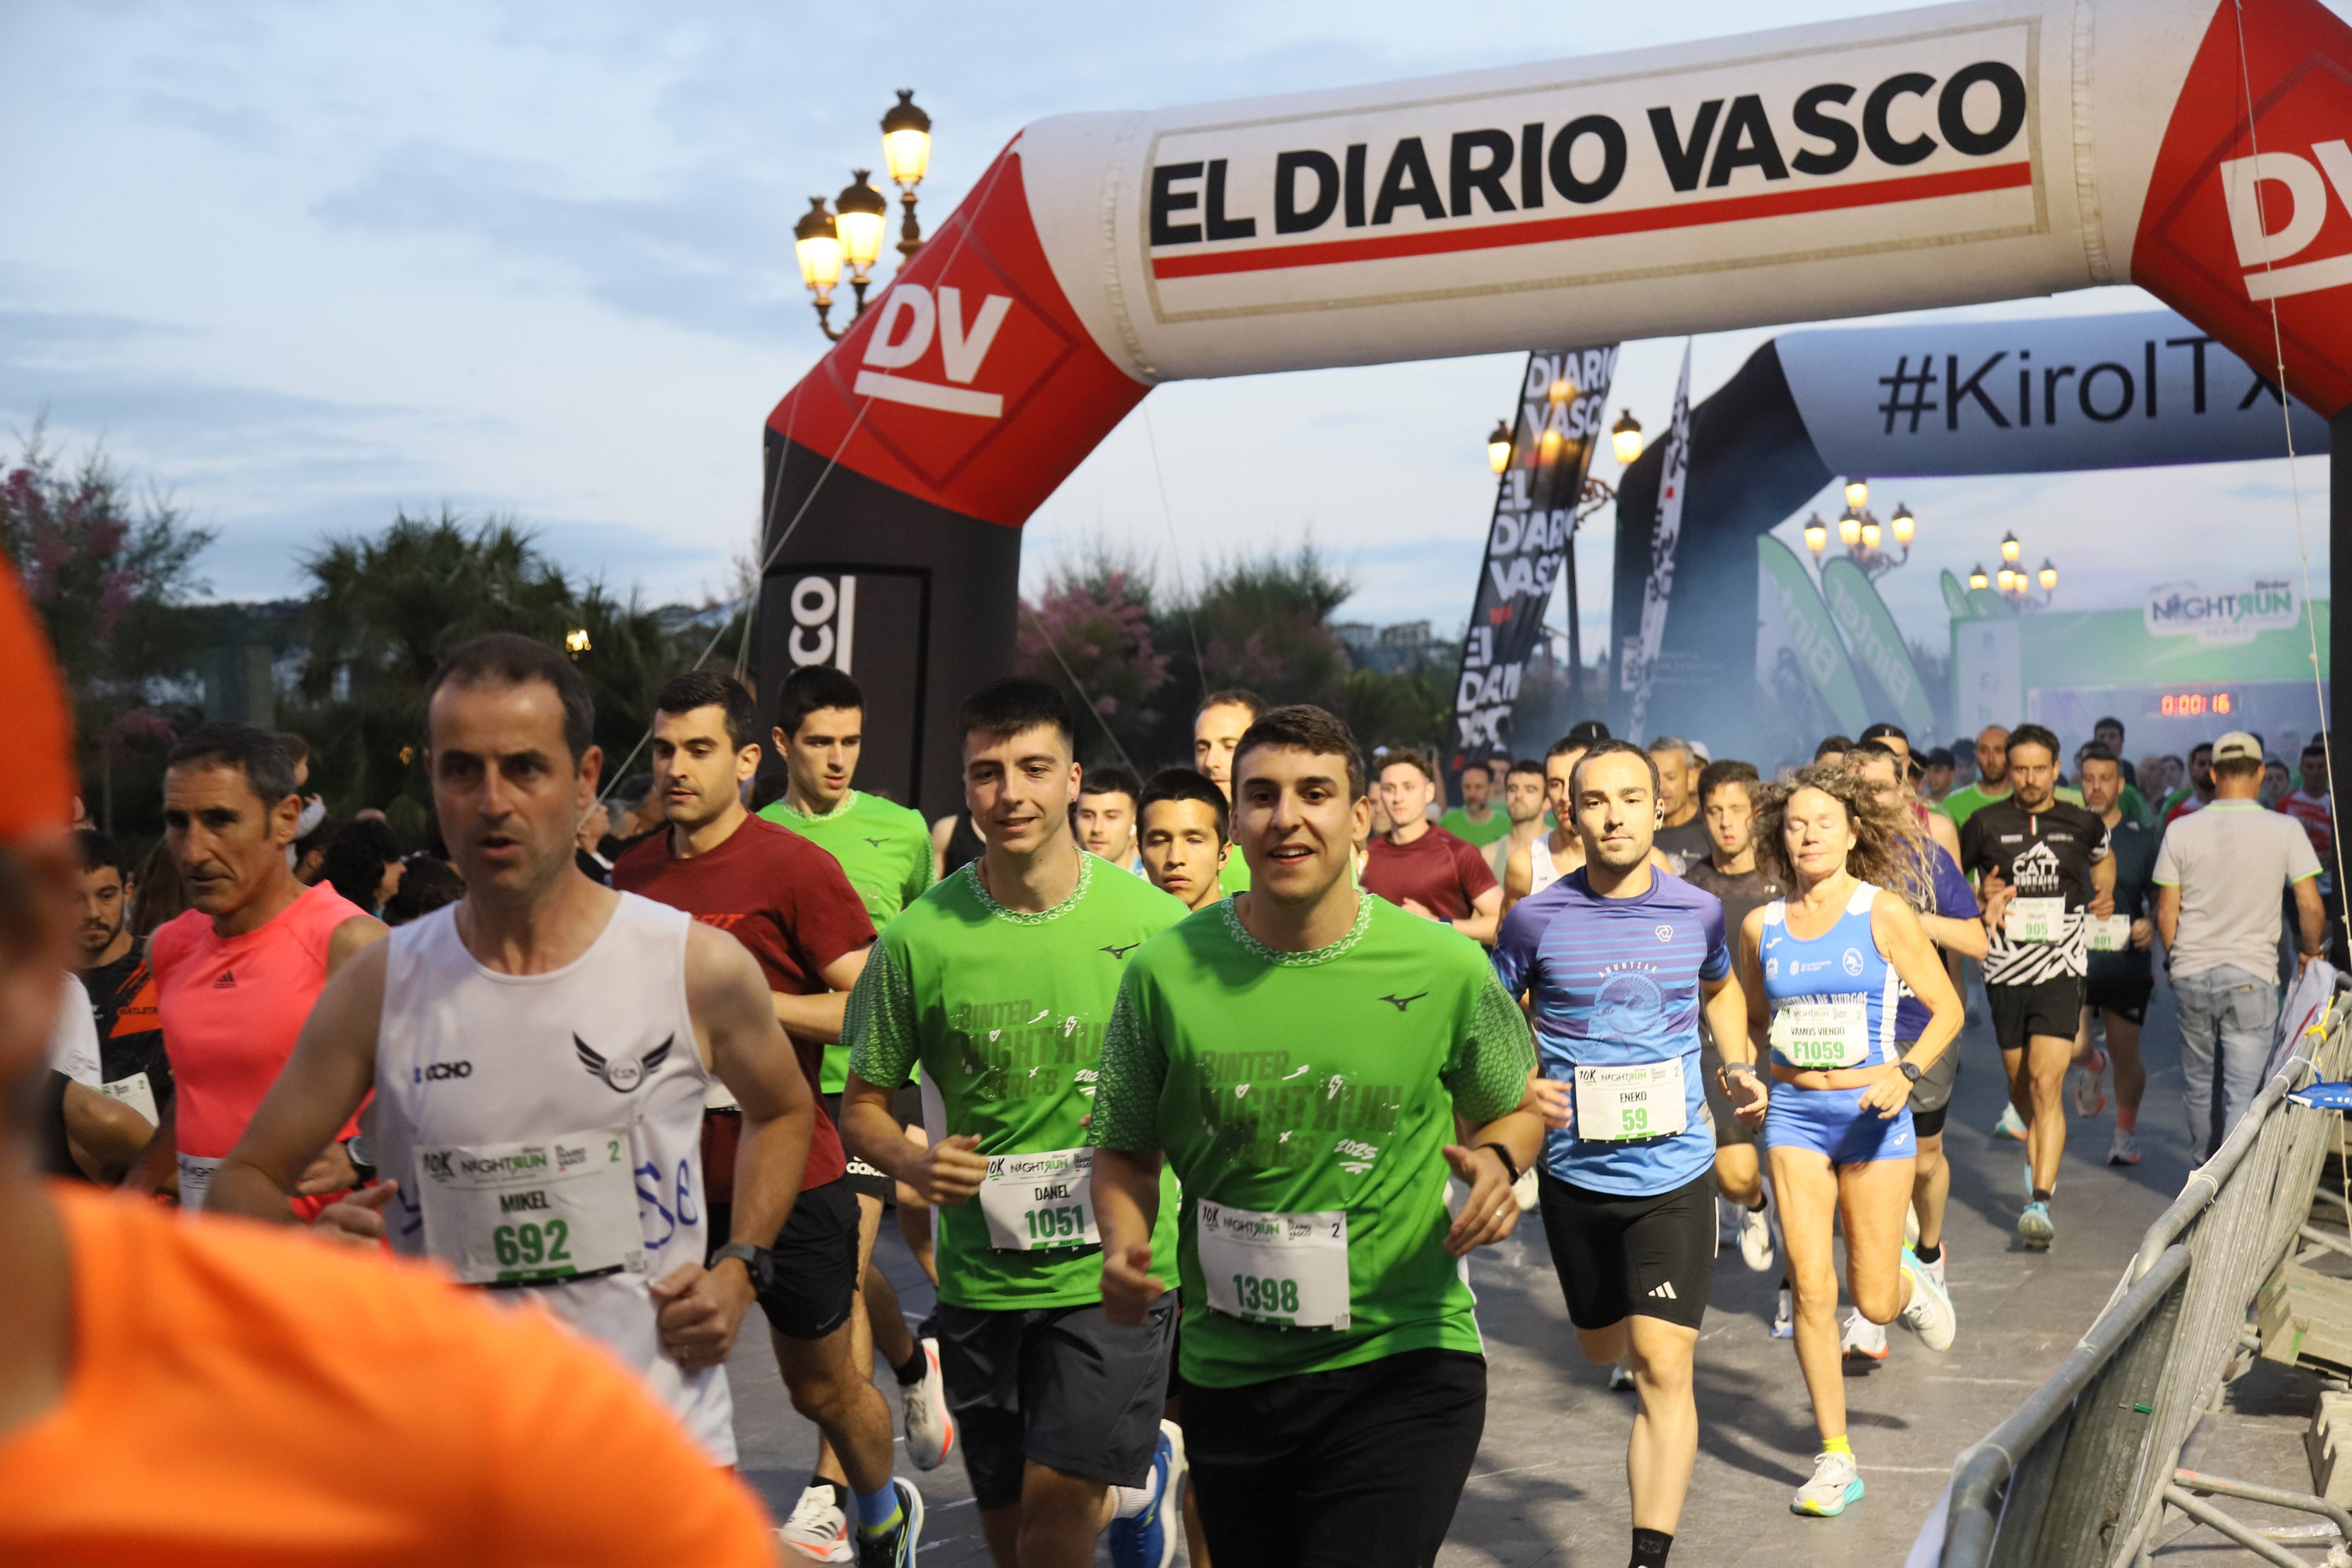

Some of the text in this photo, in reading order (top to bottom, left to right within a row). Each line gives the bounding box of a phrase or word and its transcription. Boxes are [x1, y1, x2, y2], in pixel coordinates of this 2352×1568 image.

[1150, 61, 2026, 246] EL DIARIO VASCO
[862, 284, 1013, 383] DV
[1524, 394, 1605, 445] VASC
[2012, 859, 2060, 876] CATT
[2025, 923, 2048, 935] 905
[1598, 961, 1658, 978] AHUNTZAK
[1818, 1027, 1845, 1035] VIENDO
[1793, 1041, 1845, 1060] F1059
[1074, 1069, 1099, 1082] 202
[1579, 1069, 1596, 1082] 10K
[1674, 1066, 1679, 1078] 2
[1620, 1091, 1646, 1103] ENEKO
[1622, 1108, 1648, 1131] 59
[608, 1140, 620, 1162] 2
[1334, 1138, 1378, 1160] 2025
[500, 1190, 550, 1213] MIKEL
[1025, 1205, 1085, 1238] 1051
[1202, 1206, 1219, 1224] 10K
[1332, 1223, 1341, 1238] 2
[493, 1219, 570, 1266] 692
[1233, 1274, 1298, 1313] 1398
